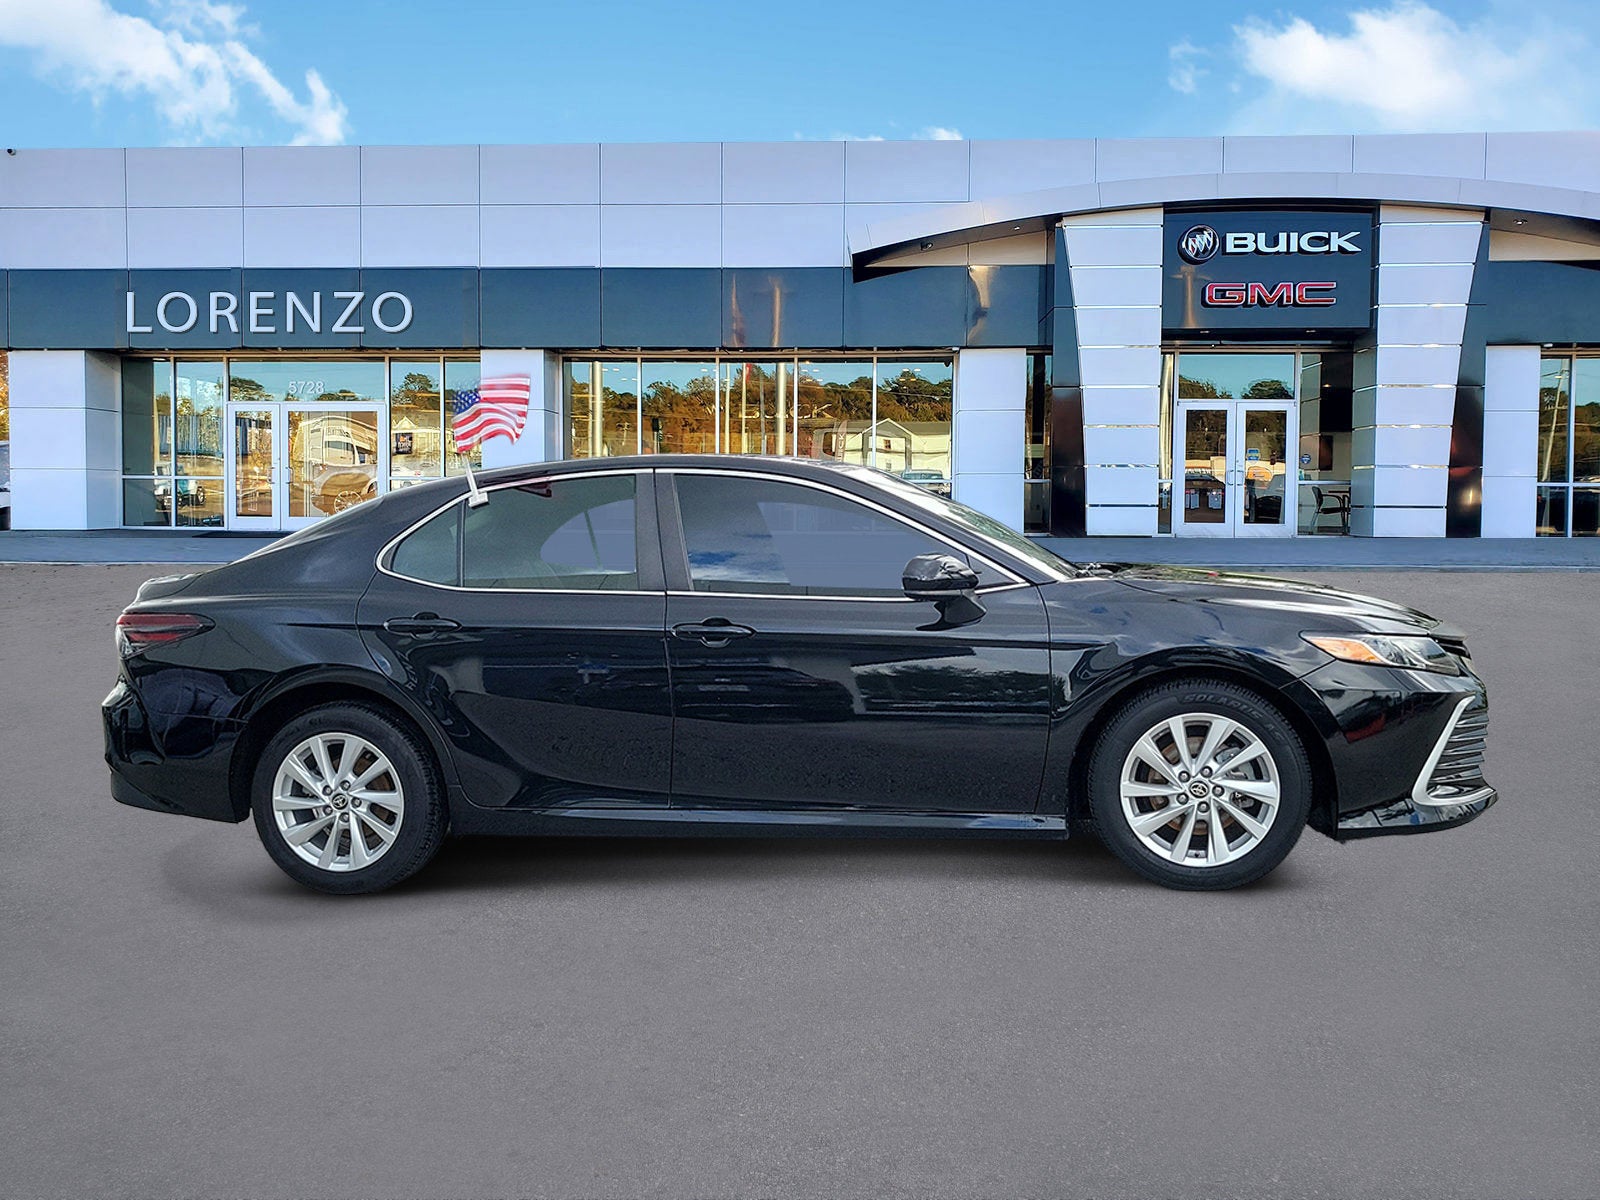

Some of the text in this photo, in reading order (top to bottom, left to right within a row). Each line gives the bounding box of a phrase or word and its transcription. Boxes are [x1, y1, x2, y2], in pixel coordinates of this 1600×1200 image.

[1224, 231, 1362, 254] BUICK
[1204, 281, 1337, 306] GMC
[126, 291, 413, 334] LORENZO
[288, 380, 325, 394] 5728
